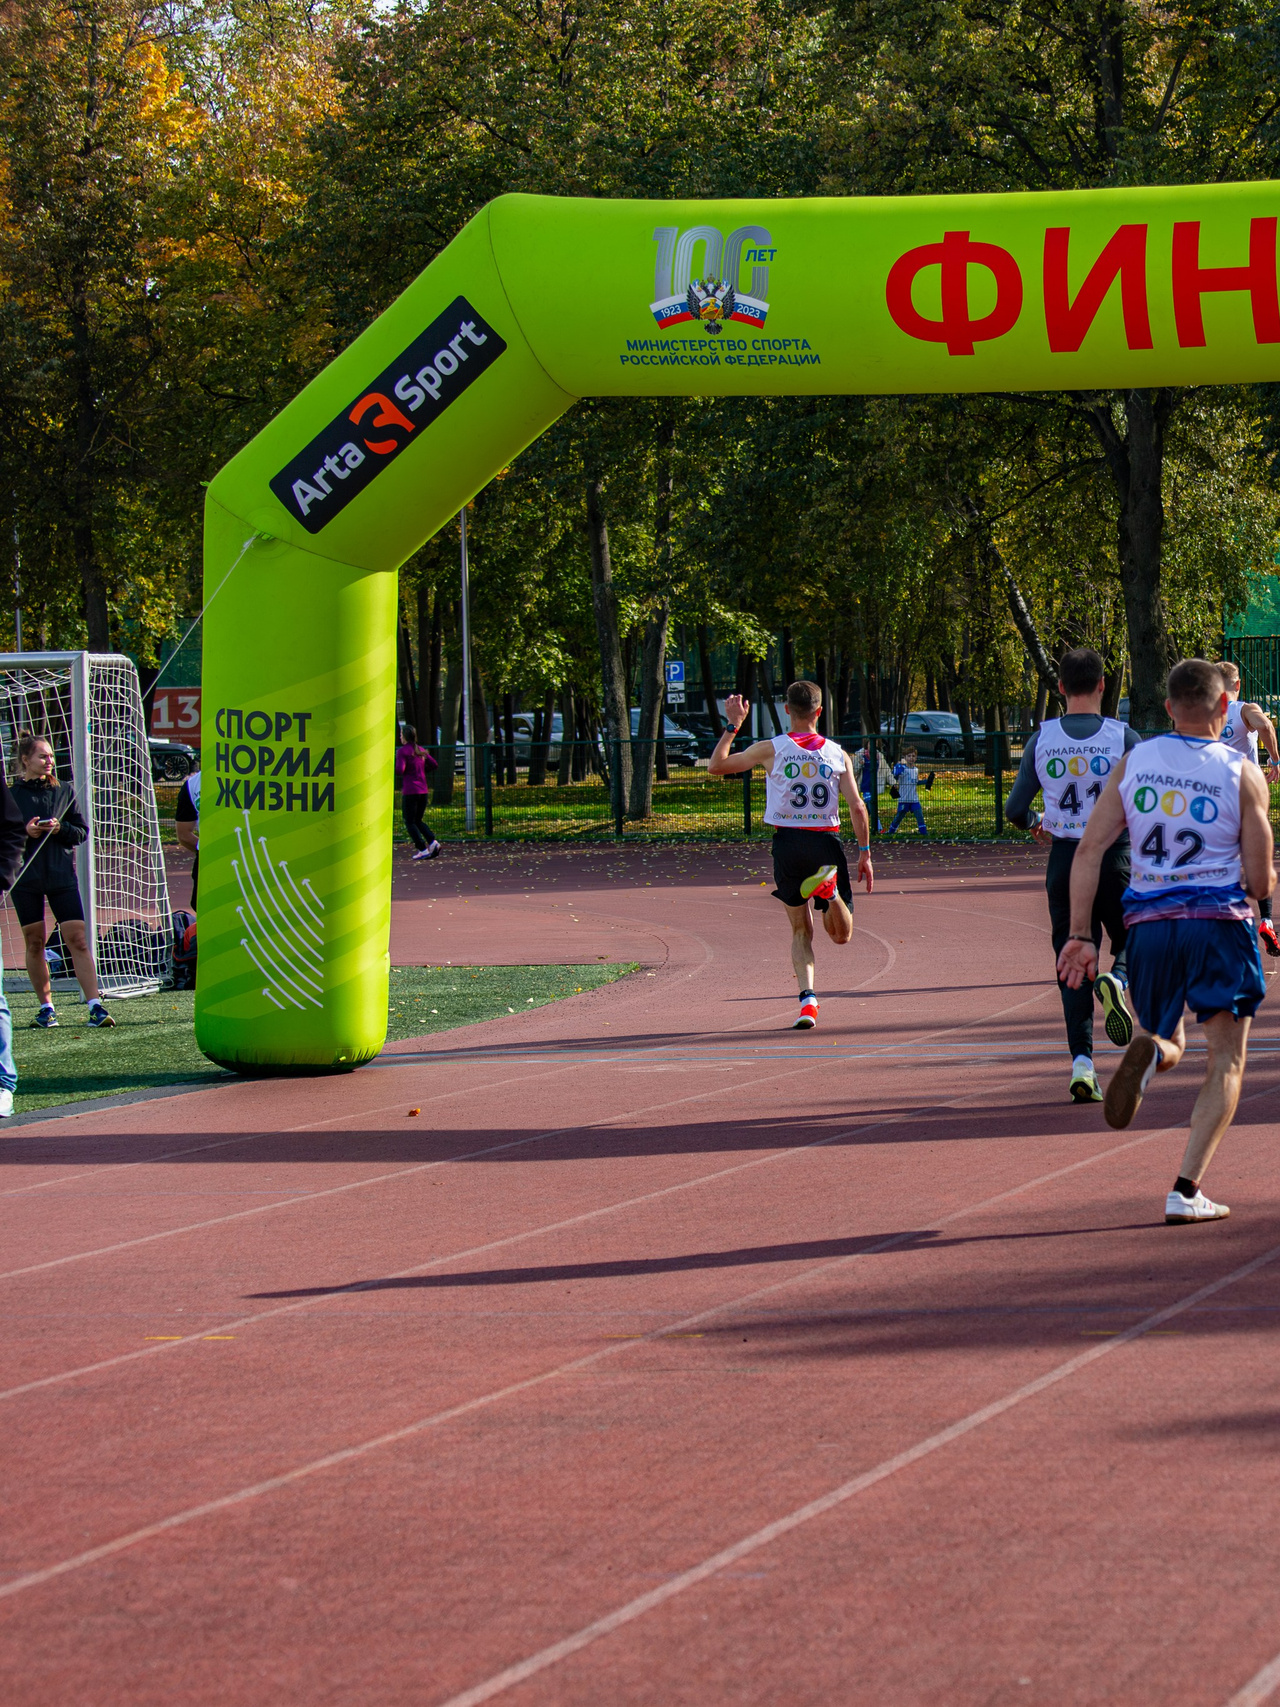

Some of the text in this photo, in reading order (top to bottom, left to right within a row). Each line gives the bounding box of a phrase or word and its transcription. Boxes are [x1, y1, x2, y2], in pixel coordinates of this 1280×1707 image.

[745, 249, 777, 262] ЛЕТ
[660, 304, 682, 318] 1923
[736, 303, 761, 319] 2023
[626, 338, 812, 351] МИНИСТЕРСТВО СПОРТА
[619, 352, 821, 367] РОССИЙСКОЙ ФЕДЕРАЦИИ
[291, 320, 488, 516] Arta Sport
[670, 664, 680, 680] P
[153, 696, 200, 729] 13
[215, 707, 312, 742] СПОРТ
[215, 741, 335, 777] НОРМА
[1045, 746, 1111, 757] VMARAFONE
[215, 776, 335, 812] ЖИЗНИ
[789, 781, 830, 810] 39
[1136, 773, 1222, 797] VMARAFONE
[1058, 781, 1103, 816] 41
[1140, 822, 1206, 870] 42
